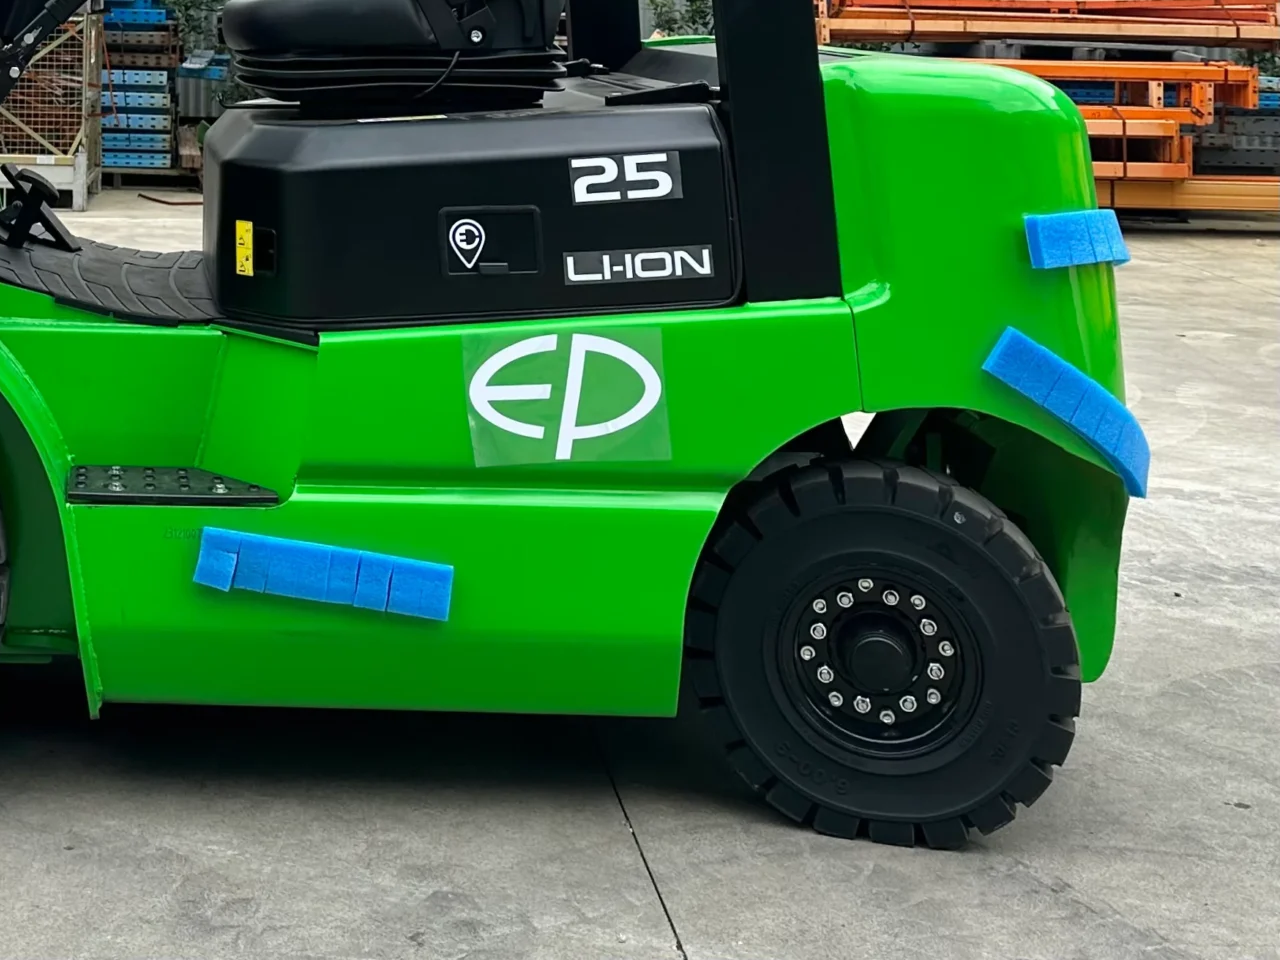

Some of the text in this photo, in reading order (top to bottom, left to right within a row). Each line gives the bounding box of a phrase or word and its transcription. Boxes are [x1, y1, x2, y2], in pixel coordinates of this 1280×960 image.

[571, 152, 673, 203] 25
[566, 248, 711, 282] LI-ION
[469, 333, 662, 460] EP
